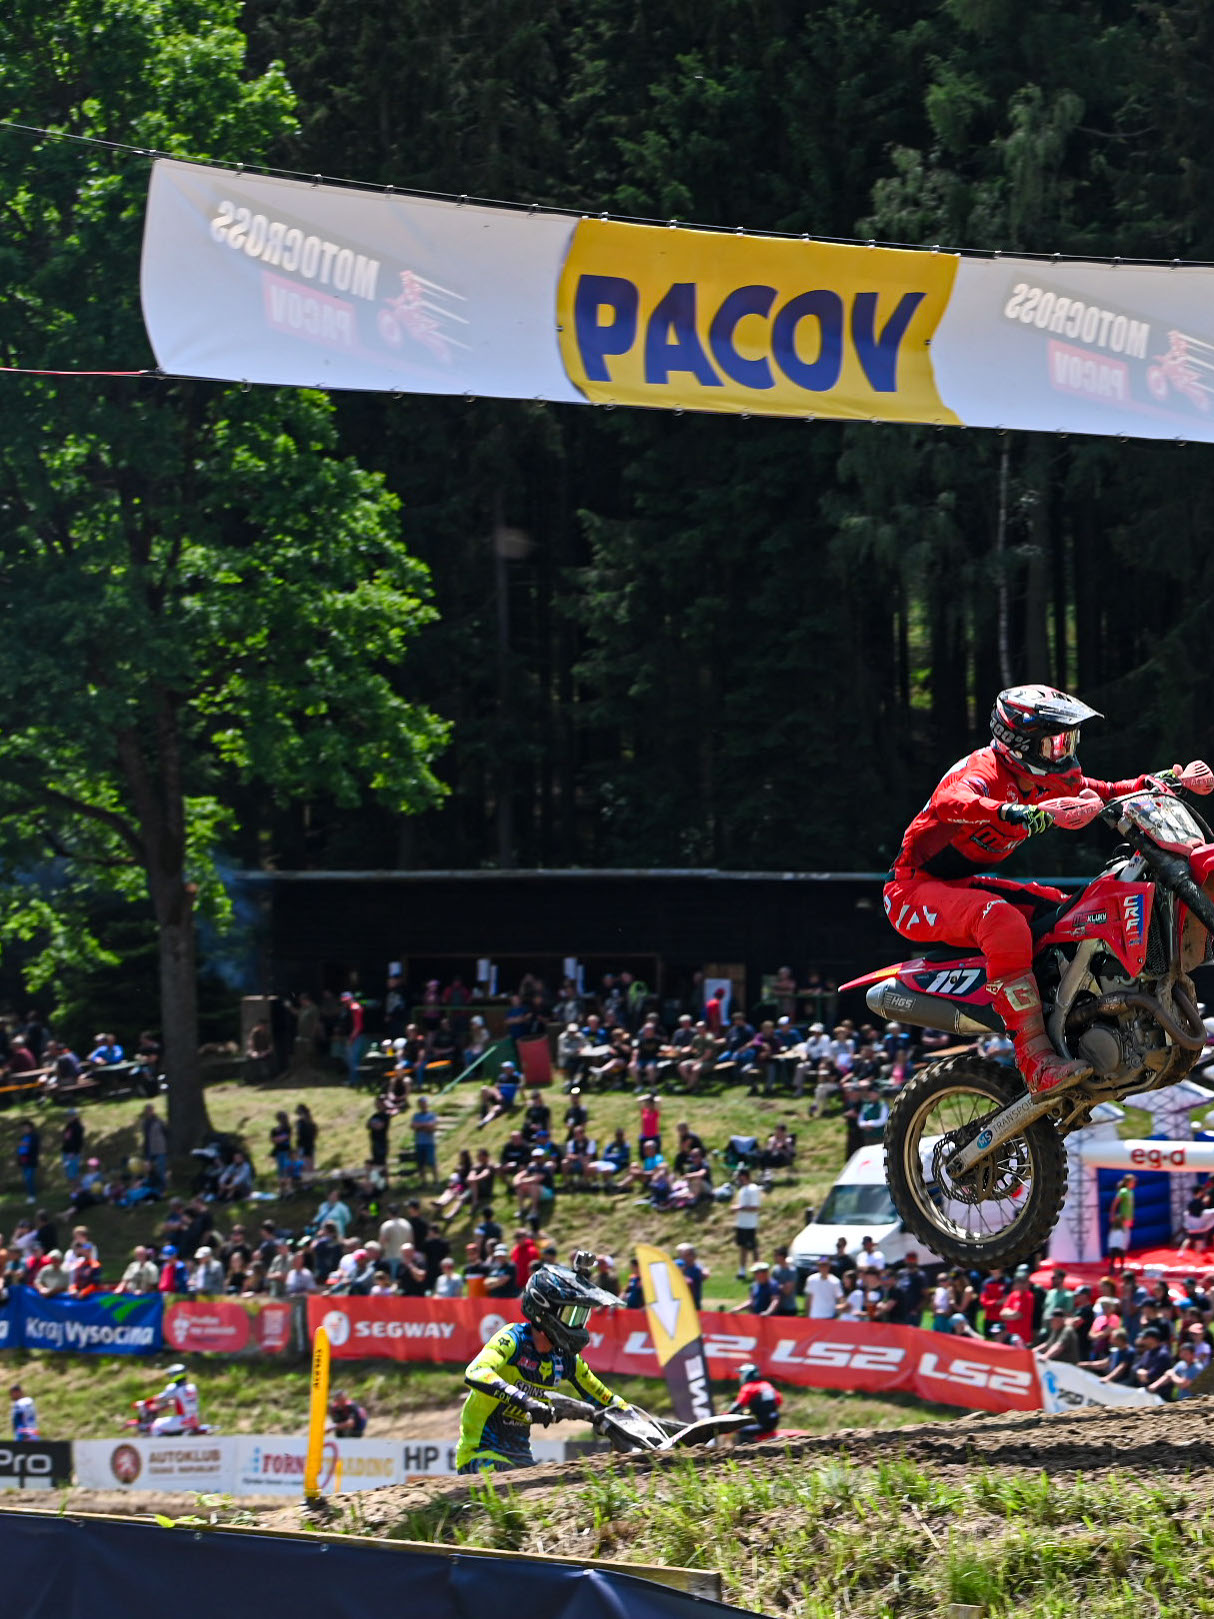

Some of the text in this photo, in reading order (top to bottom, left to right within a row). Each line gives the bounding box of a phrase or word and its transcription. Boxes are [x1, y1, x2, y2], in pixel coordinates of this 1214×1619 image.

[575, 274, 927, 392] PACOV
[993, 1100, 1034, 1132] TRANSPOR
[26, 1317, 63, 1347] Kraj
[355, 1321, 455, 1338] SEGWAY
[624, 1331, 758, 1359] L2
[771, 1339, 905, 1371] LS2
[918, 1353, 1032, 1395] LS2
[404, 1447, 438, 1470] HP
